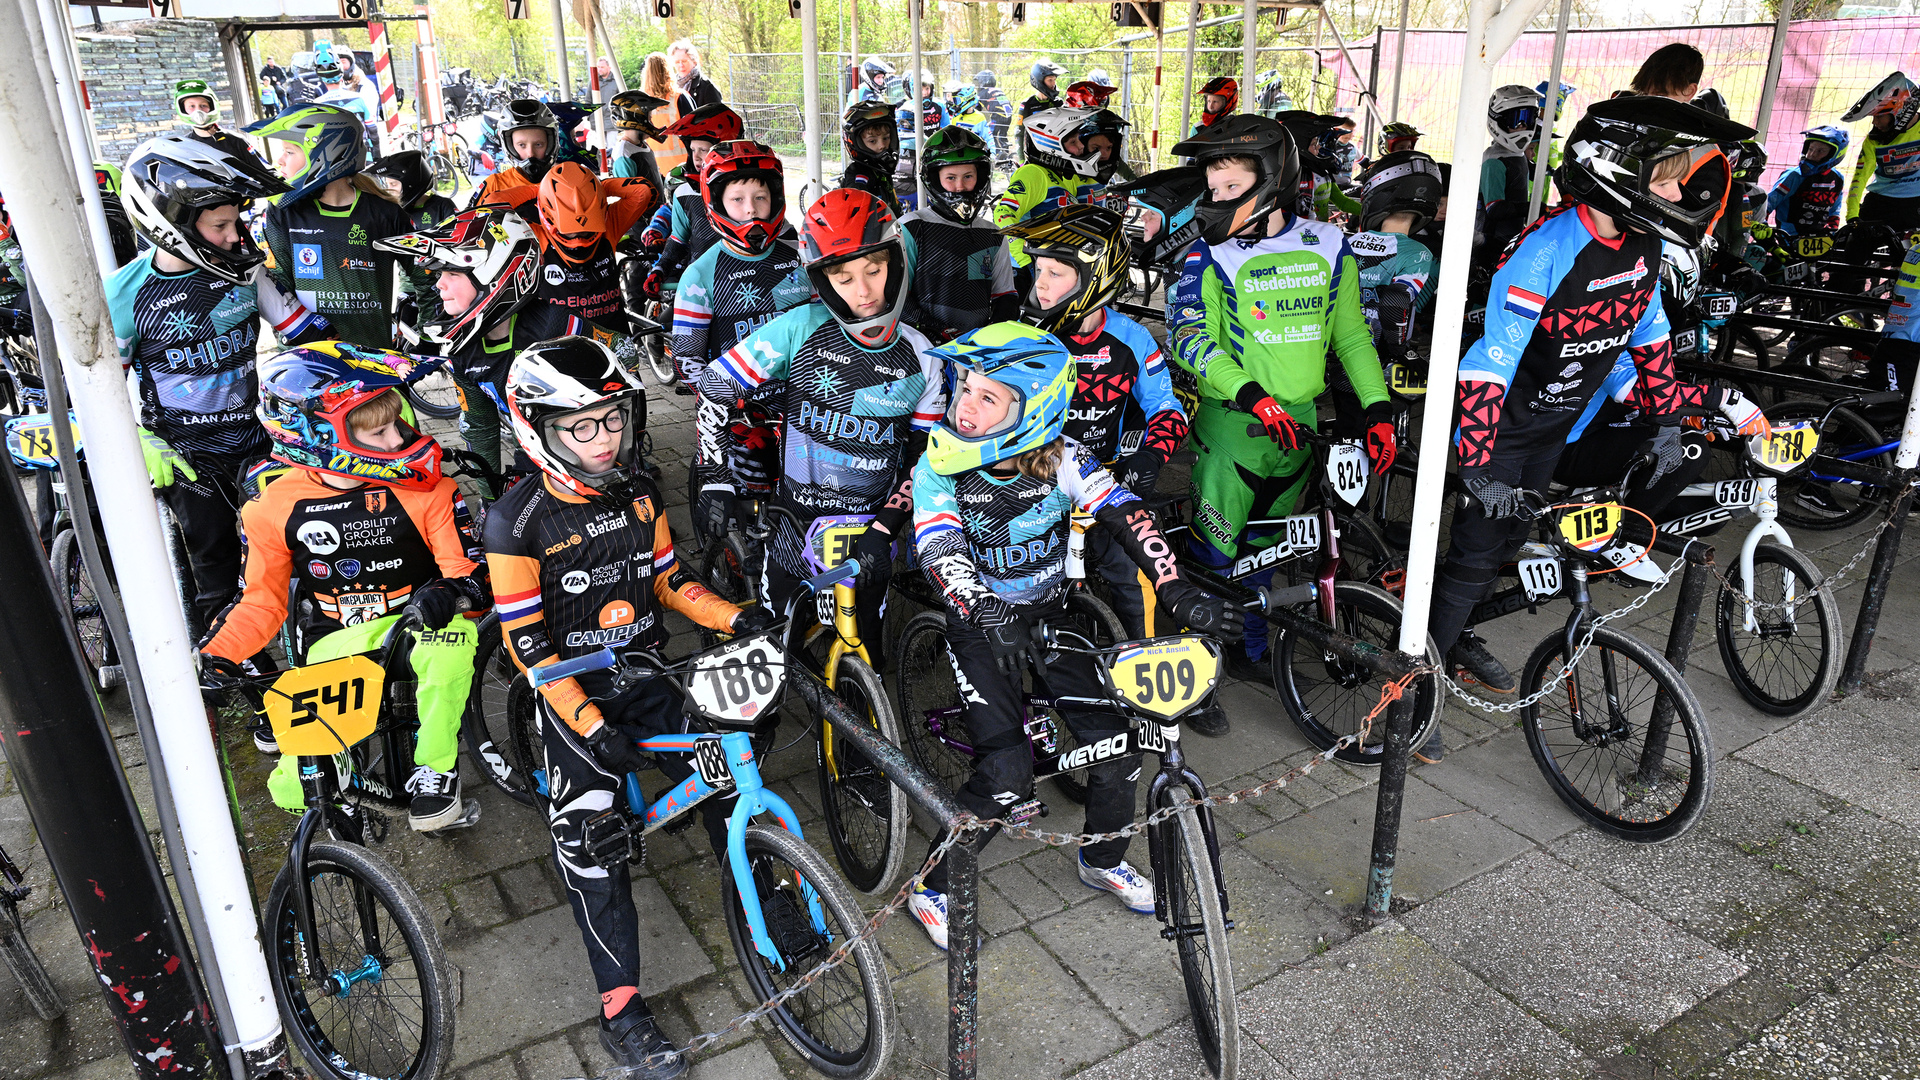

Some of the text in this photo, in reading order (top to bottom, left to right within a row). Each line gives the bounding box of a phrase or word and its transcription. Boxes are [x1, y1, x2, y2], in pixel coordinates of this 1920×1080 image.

[510, 0, 525, 19] 7
[658, 0, 670, 18] 6
[1013, 2, 1023, 21] 4
[1113, 2, 1123, 21] 3
[1675, 133, 1709, 141] KENNY
[1039, 152, 1068, 169] KENNY
[152, 225, 183, 248] FLY
[1161, 222, 1195, 252] KENNY
[1802, 239, 1823, 255] 844
[298, 266, 320, 275] Schijf
[728, 269, 756, 281] LIQUID
[1250, 263, 1319, 279] sportcentrum
[150, 292, 188, 311] LIQUID
[318, 291, 371, 300] HOLTROP
[318, 300, 383, 310] RAVESLOOT
[1276, 296, 1323, 312] KLAVER
[1711, 297, 1730, 313] 836
[1559, 327, 1632, 358] Ecopul
[817, 348, 850, 364] LIQUID
[863, 393, 879, 405] Van
[1539, 390, 1563, 404] VDA
[183, 415, 218, 426] LAAN
[1768, 431, 1804, 464] 539
[1338, 459, 1363, 490] 824
[1473, 475, 1490, 489] FLY
[963, 493, 993, 504] IQUID
[1719, 480, 1753, 503] 539
[305, 501, 353, 513] KENNY
[342, 516, 398, 532] MOBILITY
[586, 511, 628, 538] Bataaf
[1289, 518, 1317, 546] 824
[1574, 507, 1608, 542] 113
[344, 527, 387, 541] GROUP
[345, 536, 394, 548] HAAKER
[633, 550, 653, 561] Jeep
[312, 565, 327, 575] FIAT
[366, 558, 403, 572] Jeep
[591, 559, 627, 575] MOBILITY
[637, 564, 651, 579] FIAT
[592, 568, 619, 582] GROUP
[592, 575, 622, 587] HAAKER
[1526, 563, 1557, 589] 113
[340, 594, 382, 605] BIKEPLANET
[421, 631, 466, 643] SHOT
[724, 643, 741, 653] box
[1147, 645, 1191, 656] Nick Ansink
[704, 648, 775, 712] 188
[1135, 659, 1195, 704] 509
[290, 677, 365, 728] 541
[1058, 732, 1128, 771] MEYBO
[697, 741, 728, 780] 188
[300, 772, 325, 781] HARO
[362, 776, 393, 799] HARO
[299, 941, 311, 976] HARO
